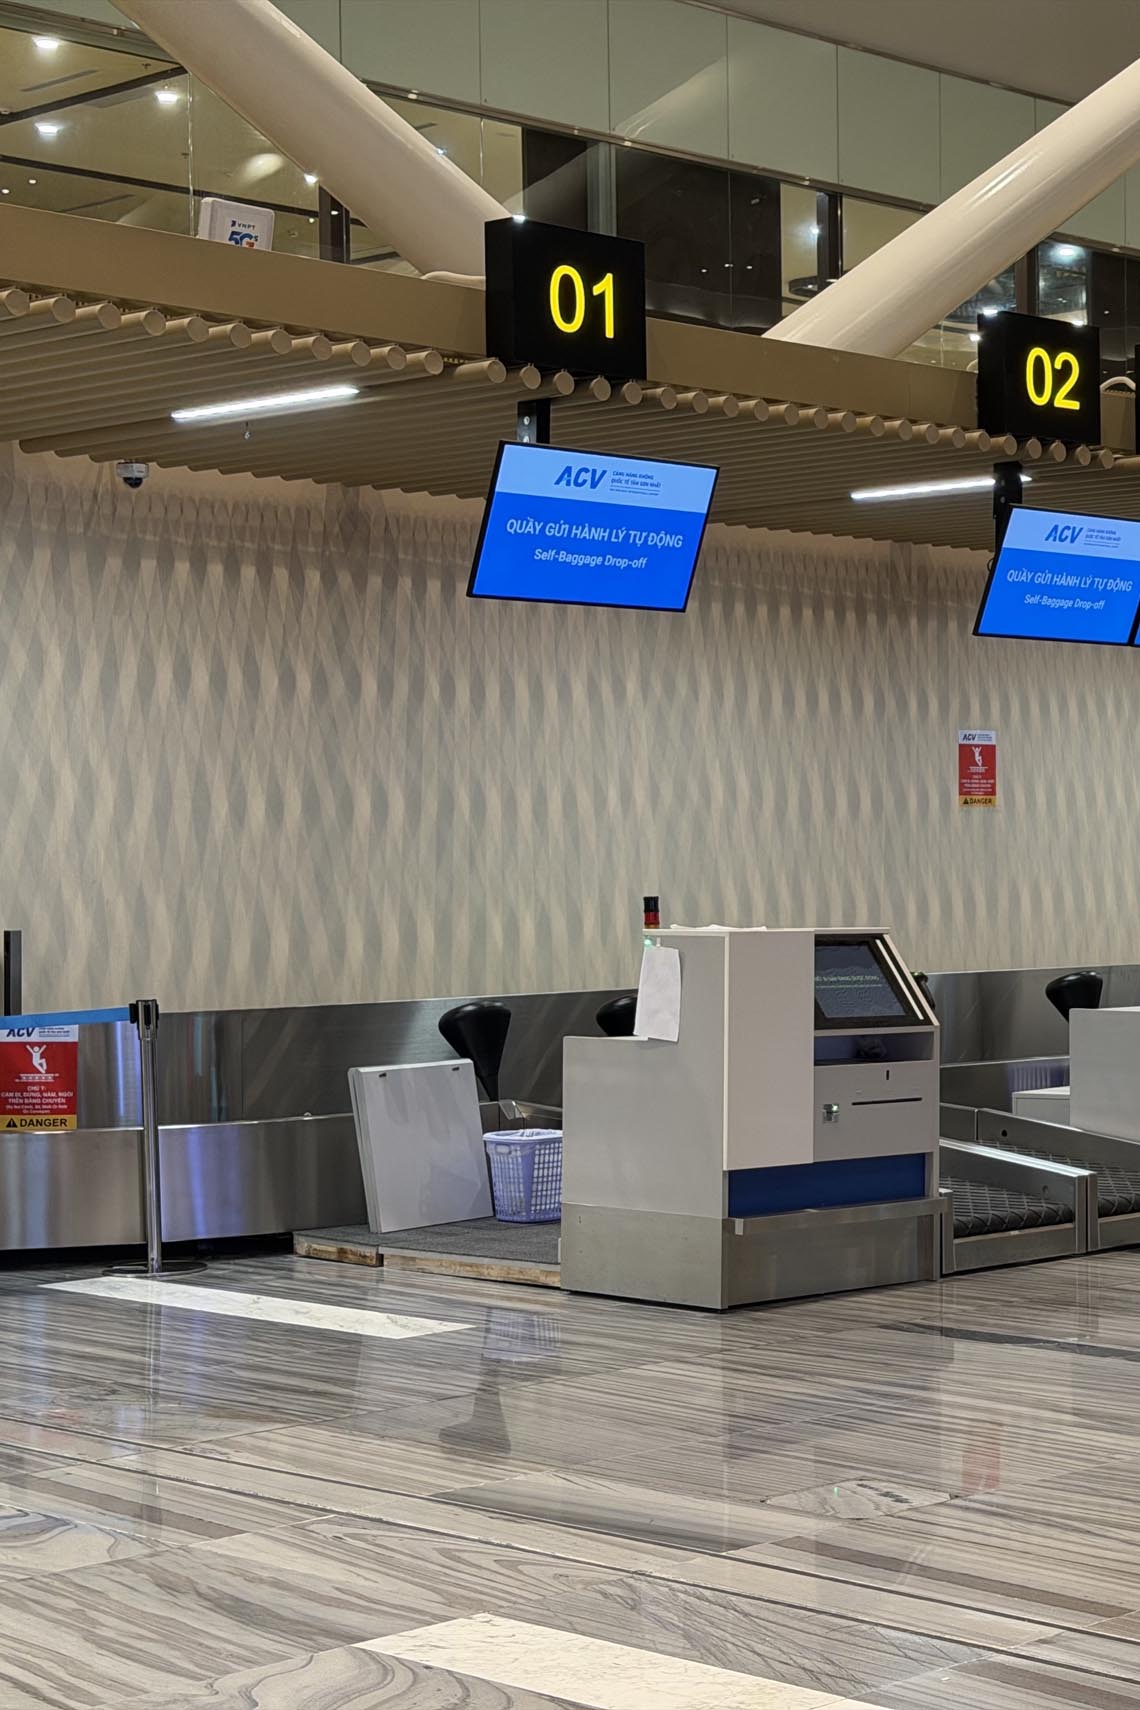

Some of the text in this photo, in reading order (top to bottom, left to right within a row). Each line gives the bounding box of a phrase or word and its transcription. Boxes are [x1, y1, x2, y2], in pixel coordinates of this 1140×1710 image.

[237, 222, 256, 230] VNPT
[549, 264, 615, 337] 01
[1025, 346, 1081, 411] 02
[554, 465, 607, 489] ACV
[506, 517, 683, 549] QUẦY GỬI HÀNH LÝ TỰ ĐỘNG
[1045, 524, 1083, 545] ACV
[534, 549, 648, 569] Self-Baggage Drop-off
[1007, 568, 1133, 592] QUẦY GỬI HÀNH LÝ TỰ ĐỘNG
[1024, 594, 1105, 611] Self-Baggage Drop-off
[962, 733, 976, 741] ACV
[6, 1027, 36, 1038] ACV
[20, 1118, 68, 1128] DANGER
